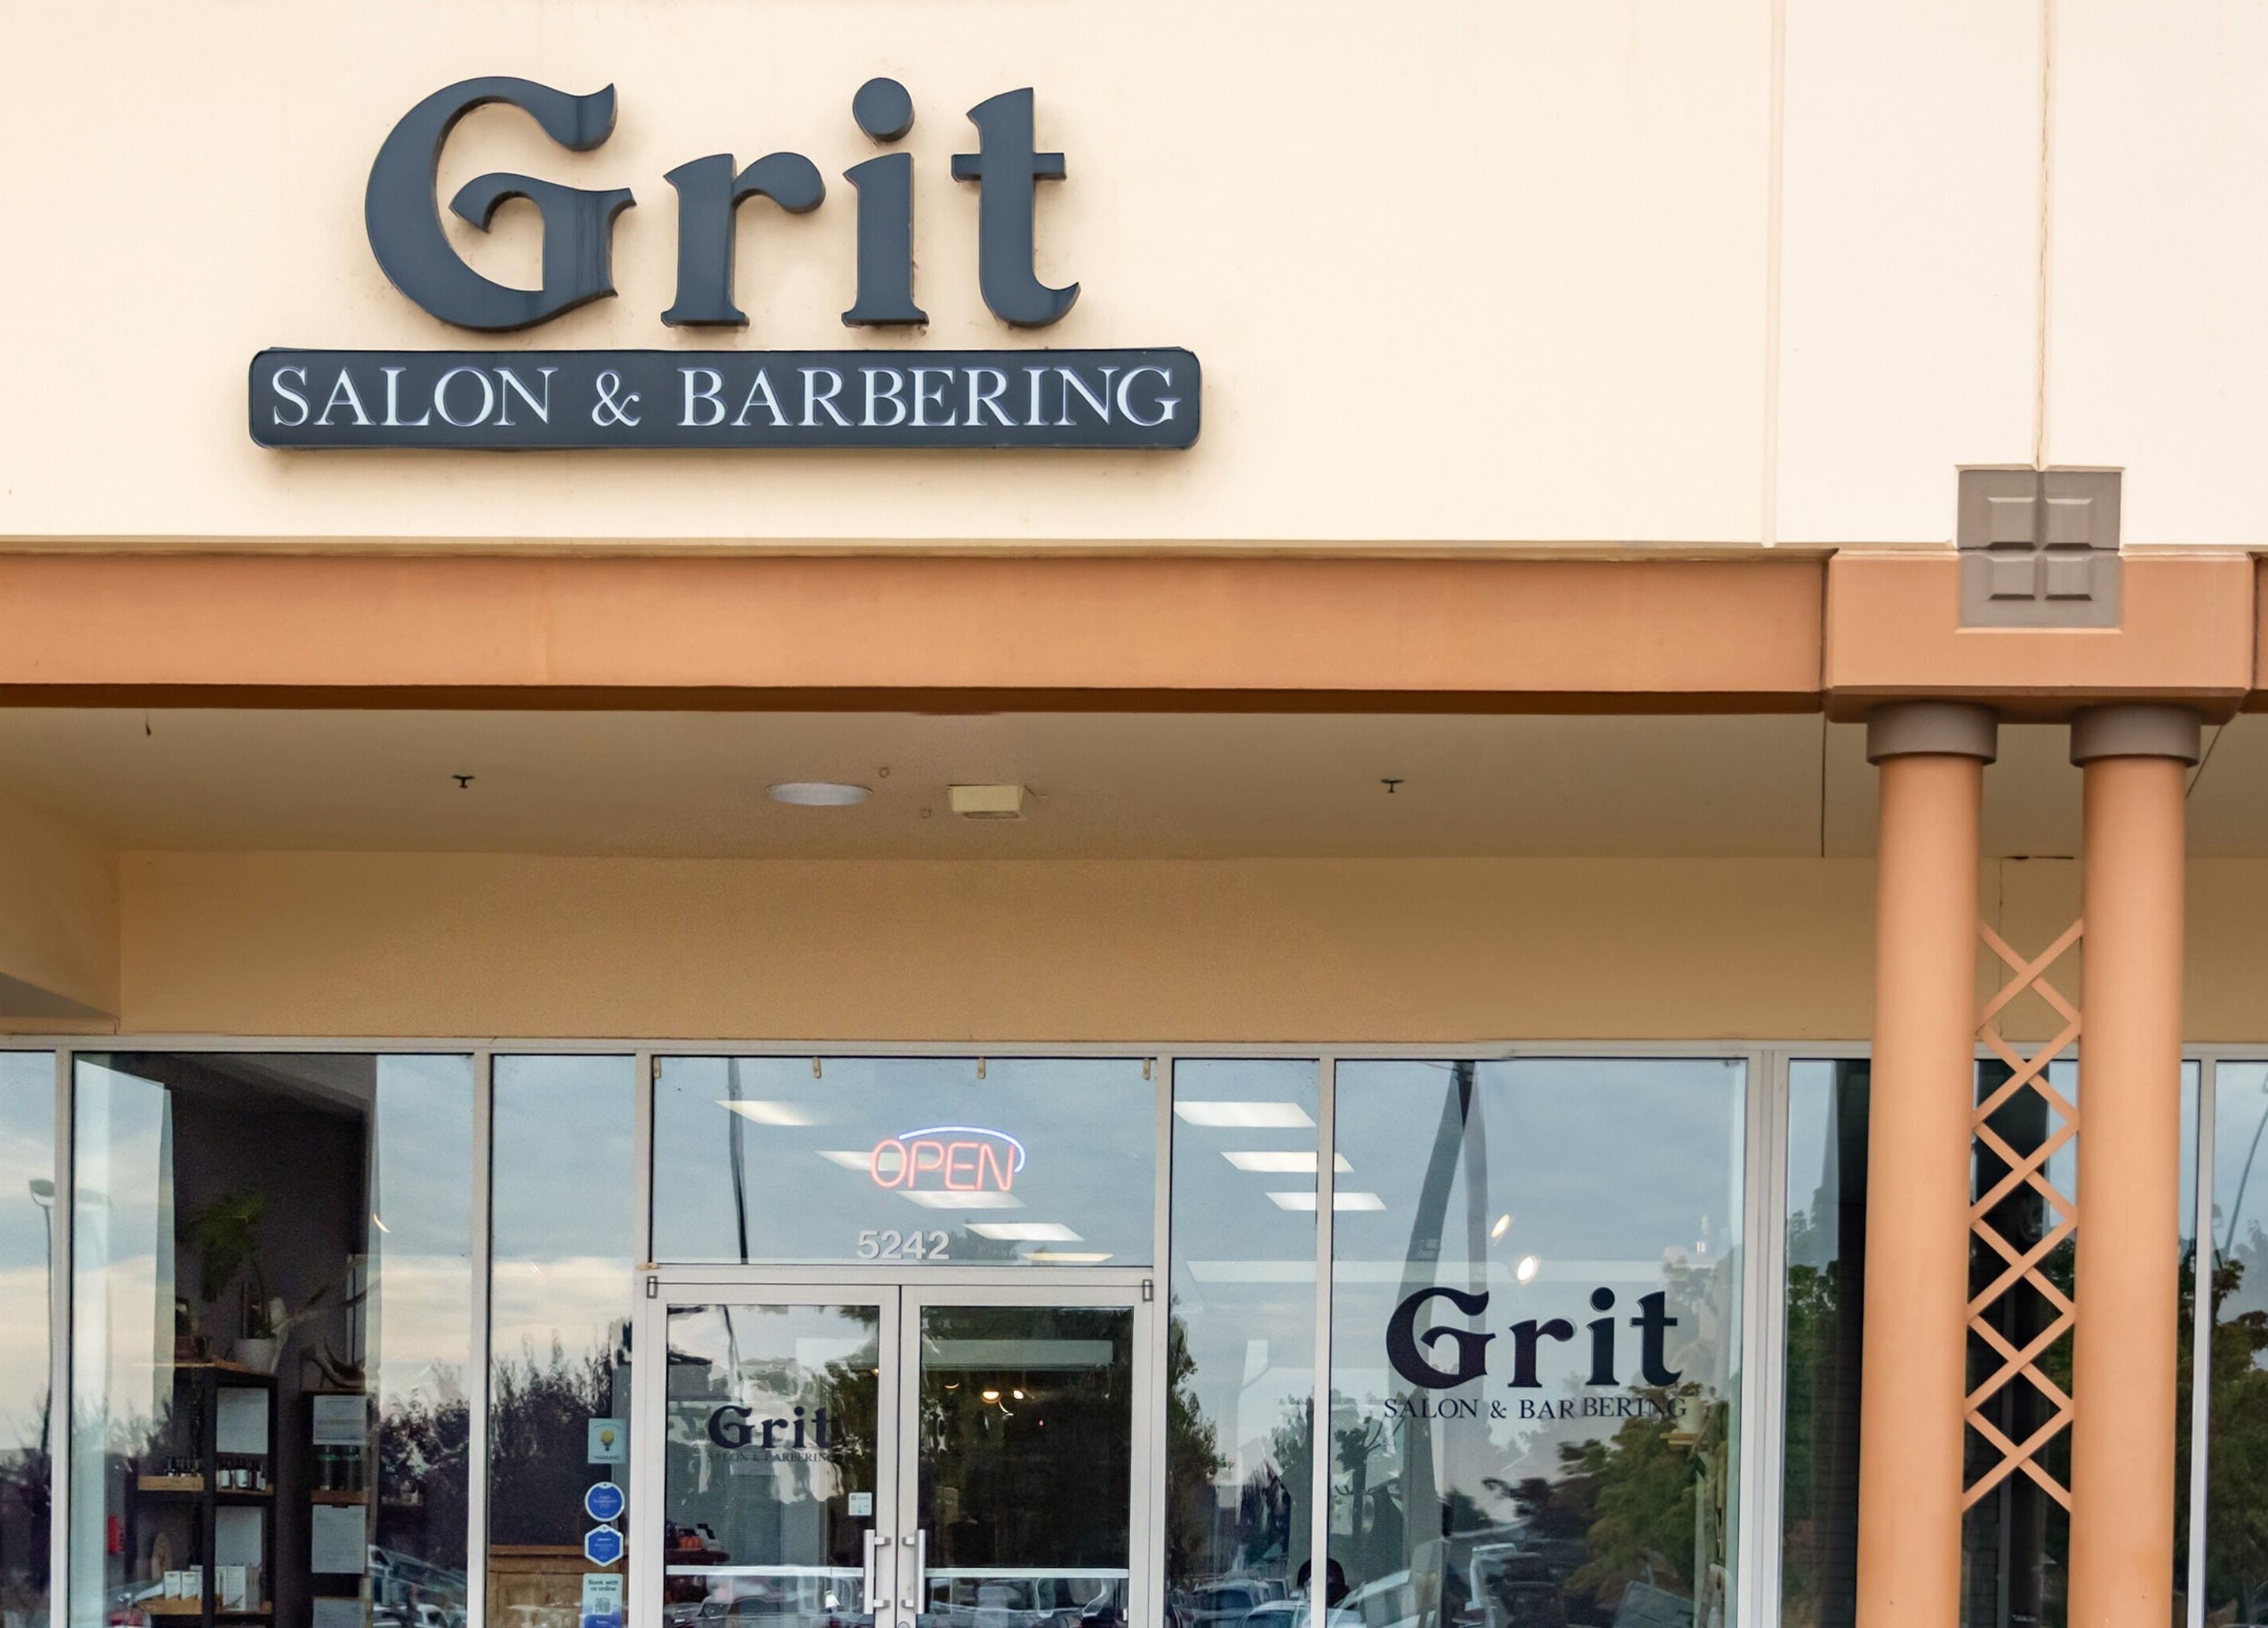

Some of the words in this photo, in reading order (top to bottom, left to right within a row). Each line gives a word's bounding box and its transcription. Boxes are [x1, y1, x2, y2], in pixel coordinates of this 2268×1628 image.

[365, 76, 1081, 333] Grit
[271, 365, 558, 429] SALON
[593, 367, 641, 429] &
[676, 365, 1181, 429] BARBERING
[871, 1138, 1016, 1191] OPEN
[858, 1229, 950, 1260] 5242
[1386, 1286, 1682, 1389] Grit
[708, 1405, 834, 1449] Grit
[1384, 1397, 1478, 1419] SALON
[1490, 1401, 1507, 1419] &
[1519, 1397, 1687, 1419] BARBERING
